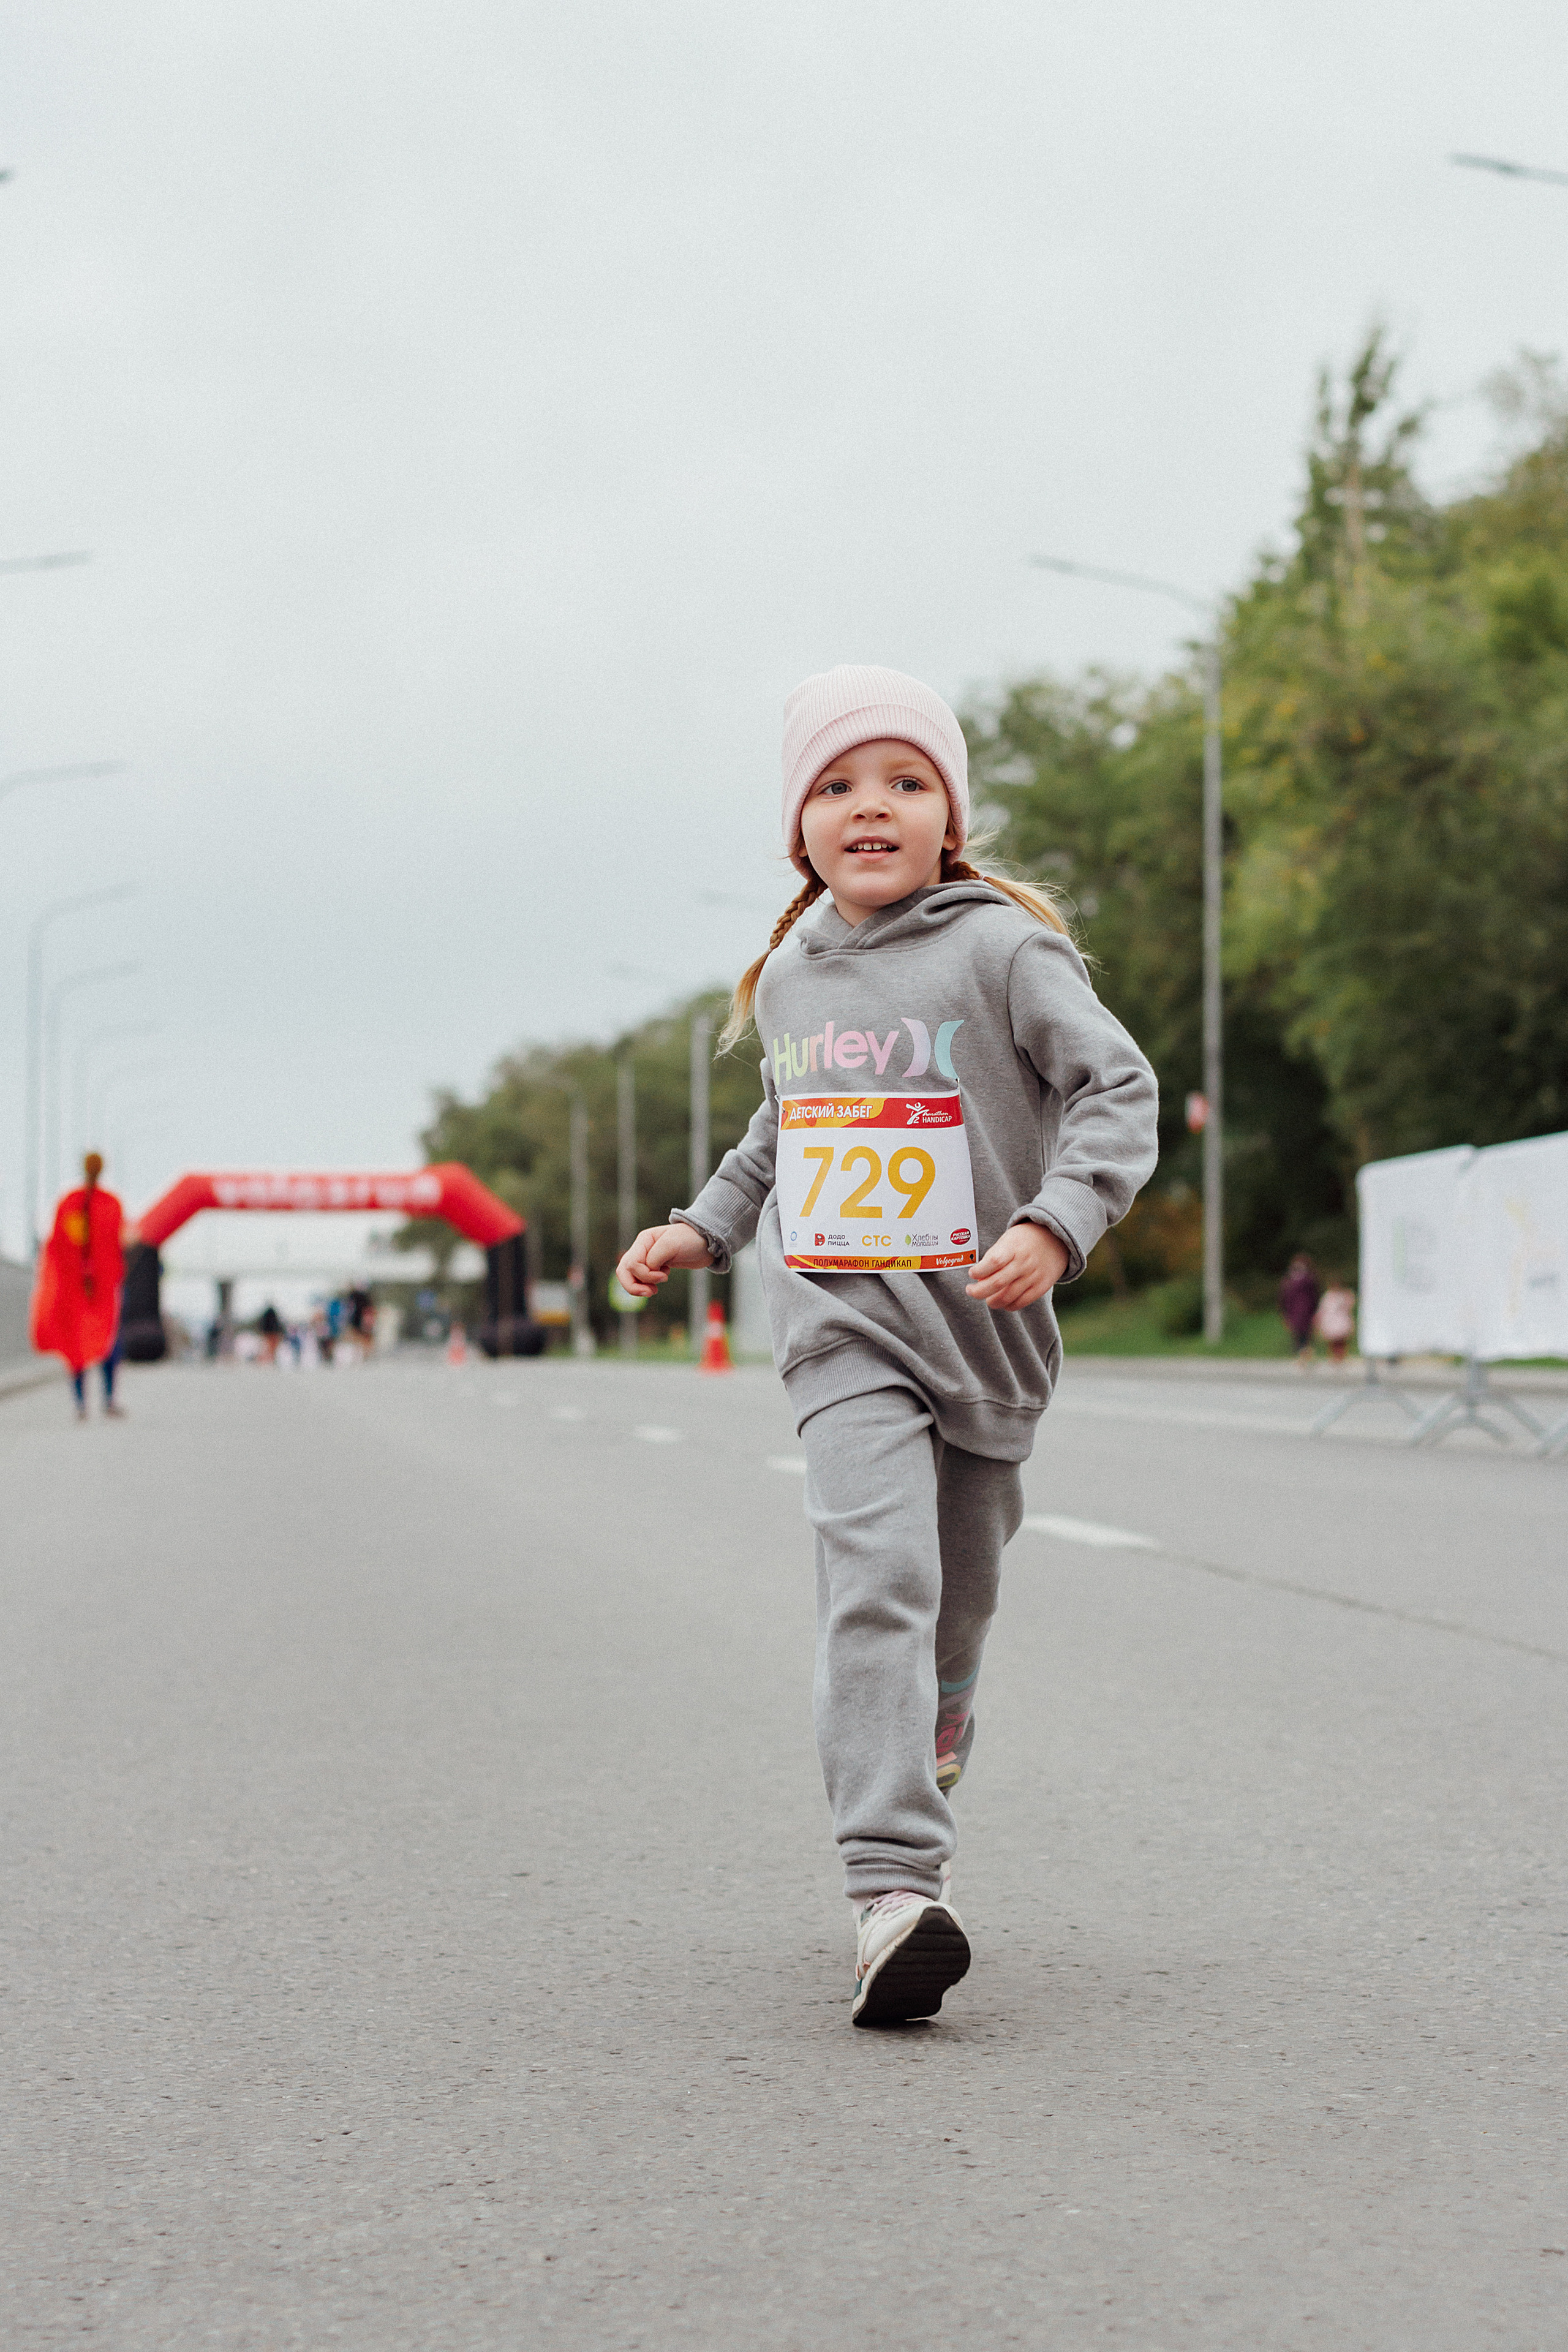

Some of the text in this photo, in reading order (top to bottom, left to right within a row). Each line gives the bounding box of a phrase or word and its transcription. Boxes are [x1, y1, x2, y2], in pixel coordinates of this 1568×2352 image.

[773, 1020, 899, 1086] Hurley
[789, 1102, 872, 1121] ДЕТСКИЙ ЗАБЕГ
[799, 1145, 936, 1219] 729
[813, 1259, 911, 1268] ПОЛУМАРАФОН ГАНДИКАП
[936, 1254, 963, 1267] Volgograd
